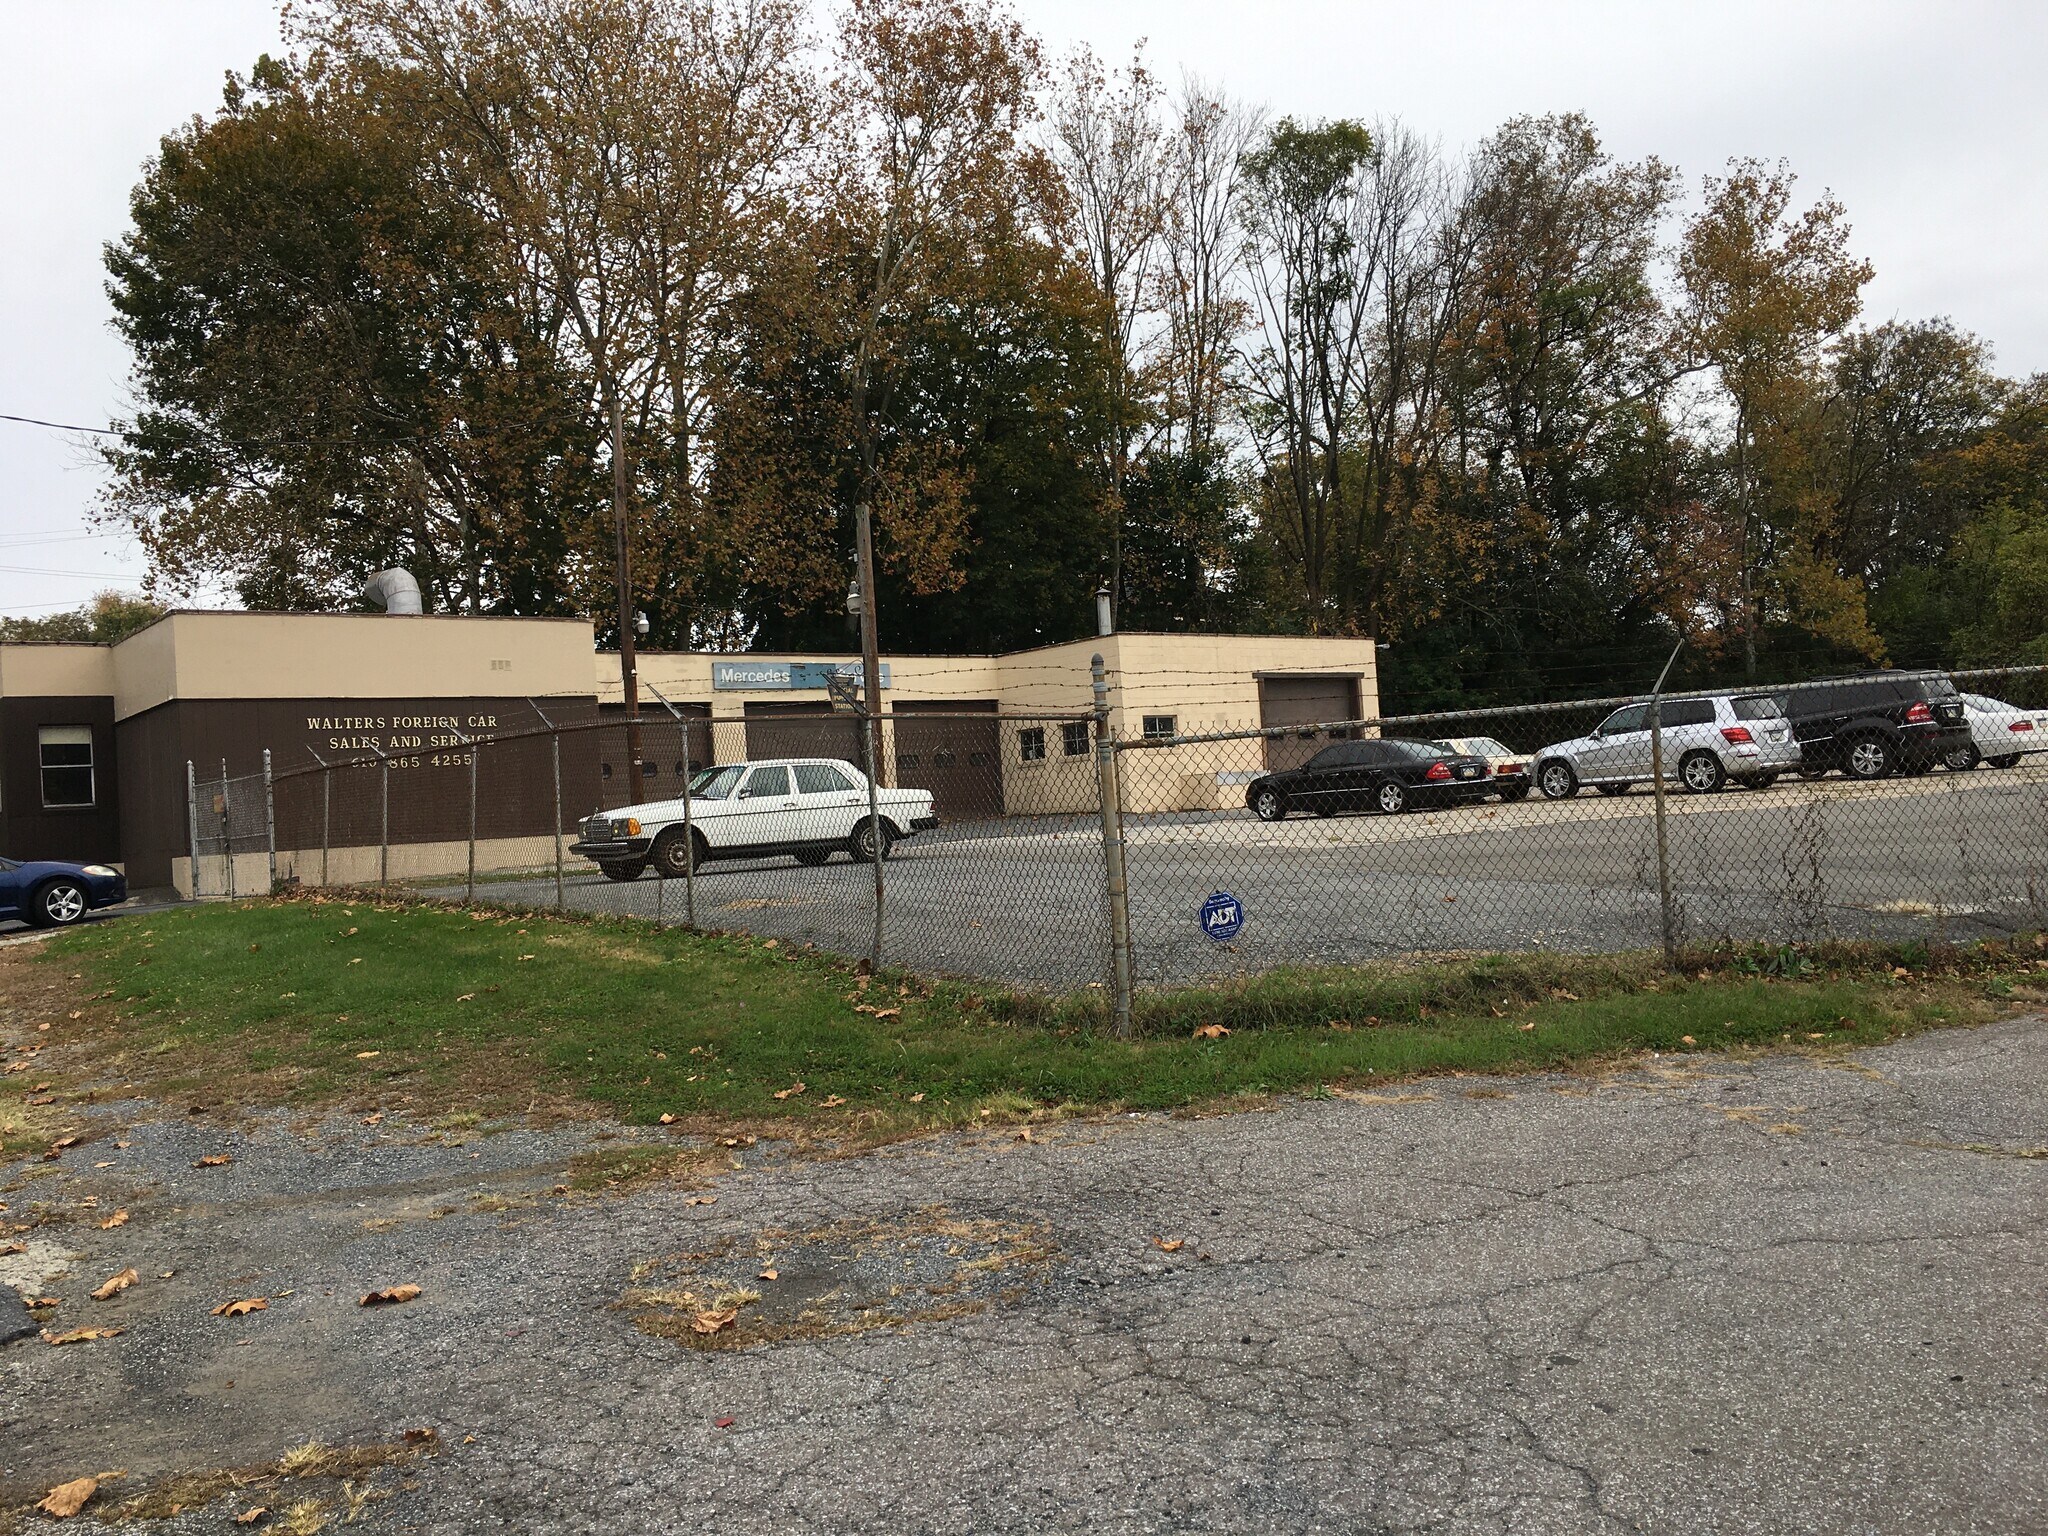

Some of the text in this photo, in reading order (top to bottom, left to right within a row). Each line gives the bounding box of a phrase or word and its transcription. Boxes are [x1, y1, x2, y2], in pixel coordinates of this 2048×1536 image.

[721, 668, 790, 683] Mercedes
[307, 715, 497, 730] WALTERS FOREIGN CAR
[329, 736, 380, 749] SALES
[389, 735, 421, 748] AND
[388, 757, 420, 769] 865
[431, 754, 472, 767] 4255
[1210, 907, 1236, 927] ADT
